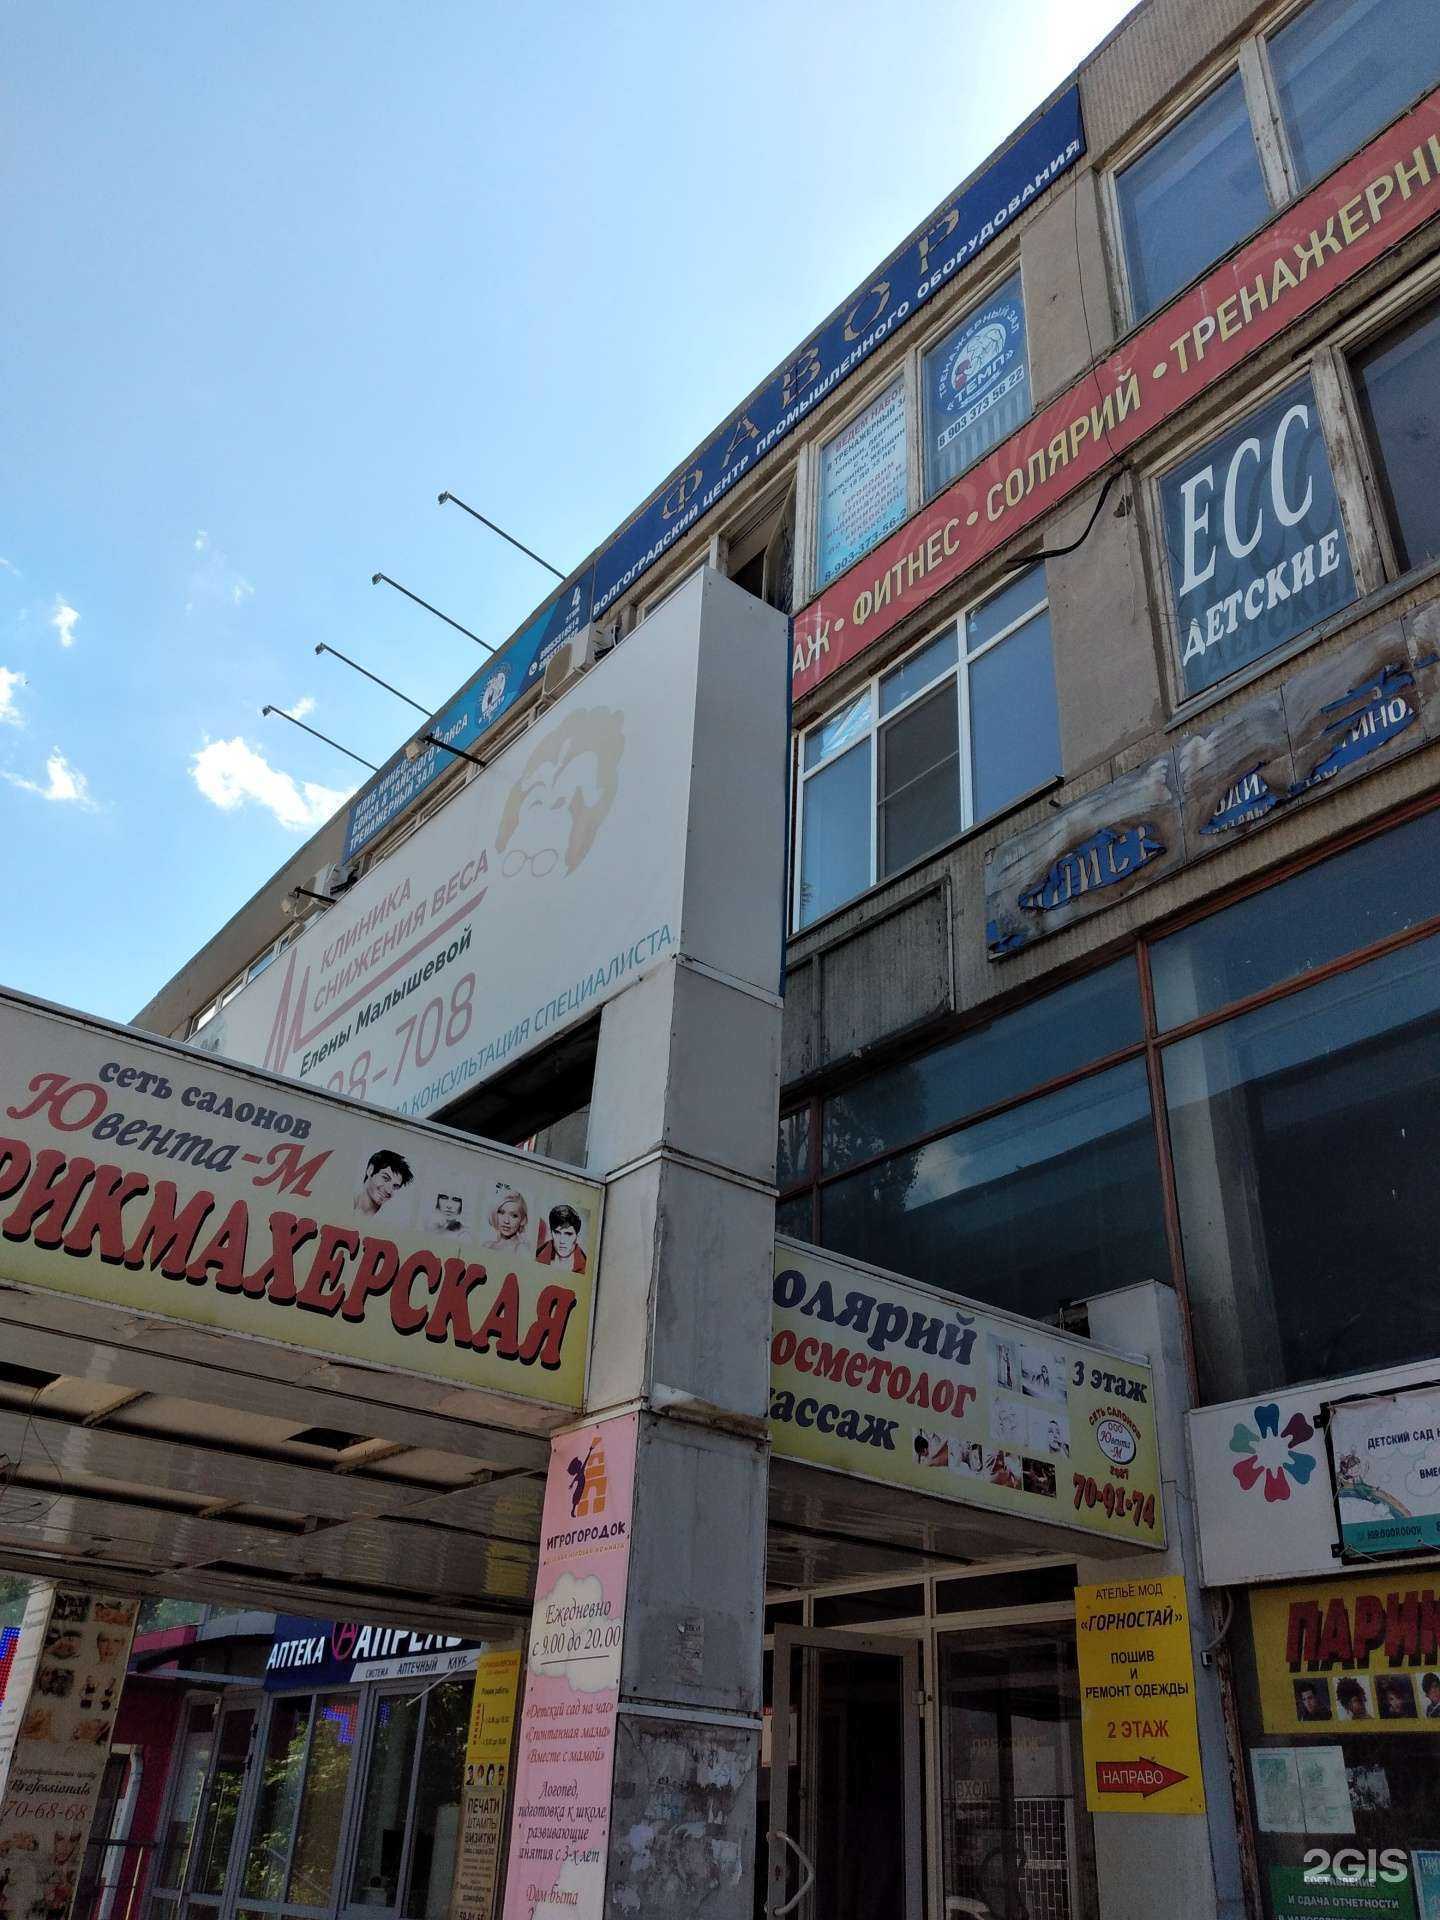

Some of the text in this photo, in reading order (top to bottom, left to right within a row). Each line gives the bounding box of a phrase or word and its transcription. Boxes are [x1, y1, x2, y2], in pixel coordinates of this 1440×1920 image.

[938, 303, 1020, 399] ТРЕНАЖЕРНЫЙ ЗАЛ
[592, 138, 1081, 617] ВОЛГОГРАДСКИЙ ЦЕНТР ПРОМЫШЛЕННОГО ОБОРУДОВАНИЯ
[948, 416, 968, 438] 903
[969, 399, 990, 420] 373
[992, 384, 1006, 398] 56
[1008, 367, 1024, 387] 22
[834, 403, 895, 465] ТРЕНАЖЕРНЫЙ
[852, 518, 961, 626] ФИТНЕС
[986, 370, 1142, 520] СОЛЯРИЙ
[1184, 529, 1341, 667] ДЕТСКИЕ
[415, 760, 436, 789] ЗАЛ
[312, 848, 489, 1013] СНИЖЕНИЯ ВЕСА
[319, 877, 412, 974] КЛИНИКА
[300, 923, 472, 1078] Елены Малышевой
[410, 1018, 530, 1114] КОНСУЛЬТАЦИЯ
[99, 1062, 312, 1140] сеть салонов
[6, 1072, 334, 1198] Ювента-М
[770, 1329, 977, 1418] осметолог
[1072, 1360, 1148, 1404] 3 этаж
[769, 1387, 900, 1451] ассаж
[1367, 1427, 1435, 1450] ДЕТСКИЙ САД
[1072, 1472, 1156, 1530] 70-91-74
[546, 1520, 626, 1550] ИГРОГОРОДОК
[1095, 1582, 1163, 1601] АТЕЛЬЕ МОД
[545, 1598, 612, 1628] Ежедневно
[1080, 1605, 1184, 1633] «ГОРНОСТАЙ»
[266, 1635, 326, 1671] АПТЕКА
[532, 1625, 622, 1657] с 9.00 до 20.00
[397, 1657, 438, 1675] АПТЕЧНЫЙ
[1110, 1649, 1155, 1665] ПОШИВ
[1129, 1667, 1139, 1681] И
[1085, 1681, 1189, 1699] РЕМОНТ ОДЕЖДЫ
[566, 1698, 581, 1716] сад
[582, 1703, 594, 1716] на
[1107, 1719, 1170, 1739] 2 ЭТАЖ
[1102, 1769, 1164, 1786] НАПРАВО
[467, 1798, 500, 1814] ПЕЧАТИ
[567, 1807, 575, 1822] к
[526, 1826, 590, 1845] развивающие
[580, 1848, 600, 1863] лет
[1297, 1896, 1330, 1906] СДАЧА
[1332, 1897, 1400, 1909] ОТЧЕТНОСТИ
